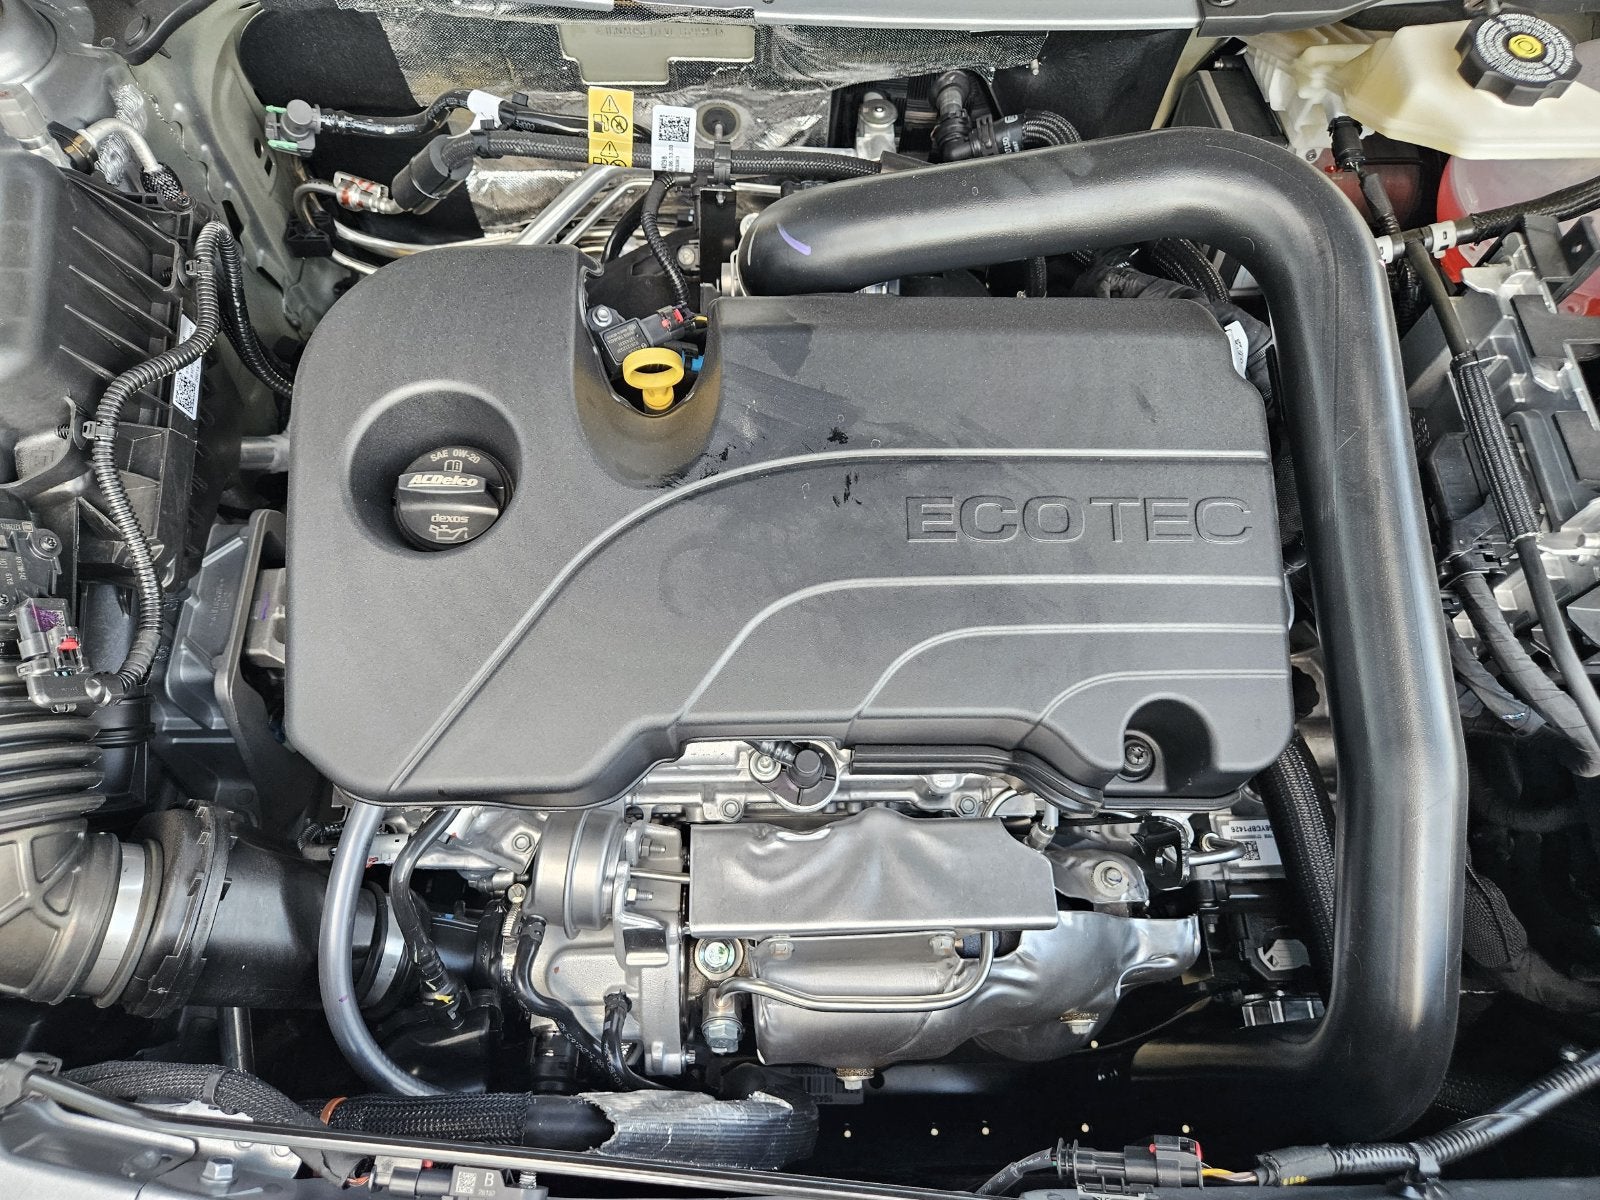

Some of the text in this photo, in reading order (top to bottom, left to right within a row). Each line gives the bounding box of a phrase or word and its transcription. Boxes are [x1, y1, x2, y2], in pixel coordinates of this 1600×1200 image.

[430, 448, 481, 464] SAE 0W-20
[408, 474, 479, 487] ACDelco
[431, 513, 470, 523] dexos
[905, 494, 1253, 545] ECOTEC
[484, 1172, 495, 1187] B
